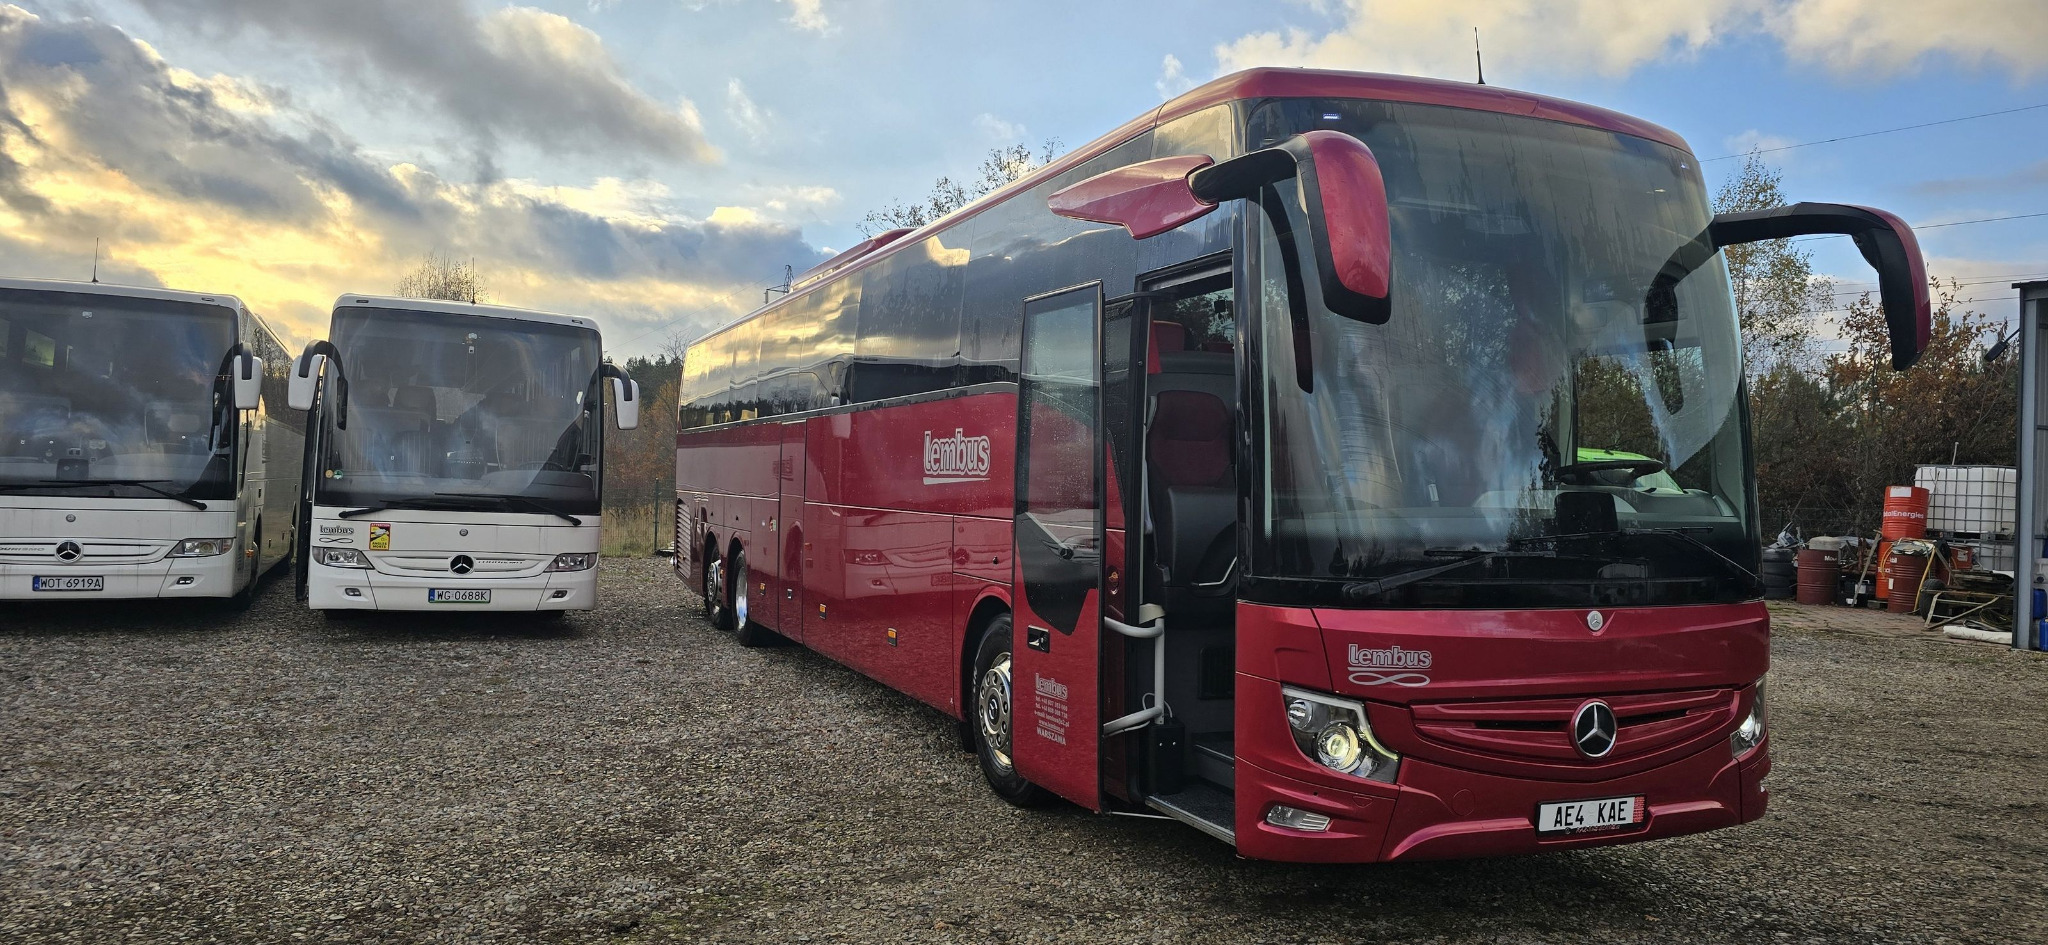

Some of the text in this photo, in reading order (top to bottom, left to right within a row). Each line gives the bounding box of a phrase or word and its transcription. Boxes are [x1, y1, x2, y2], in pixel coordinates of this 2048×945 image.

[924, 428, 990, 475] lembus
[320, 525, 354, 534] lembus
[40, 579, 62, 588] WOT
[66, 578, 101, 588] 6919A
[437, 591, 487, 601] WG 0688K
[1348, 643, 1432, 669] lembus
[1036, 673, 1067, 700] lembus
[1037, 727, 1066, 745] WARSZAWA
[1553, 804, 1585, 828] AE4
[1597, 800, 1628, 823] KAE
